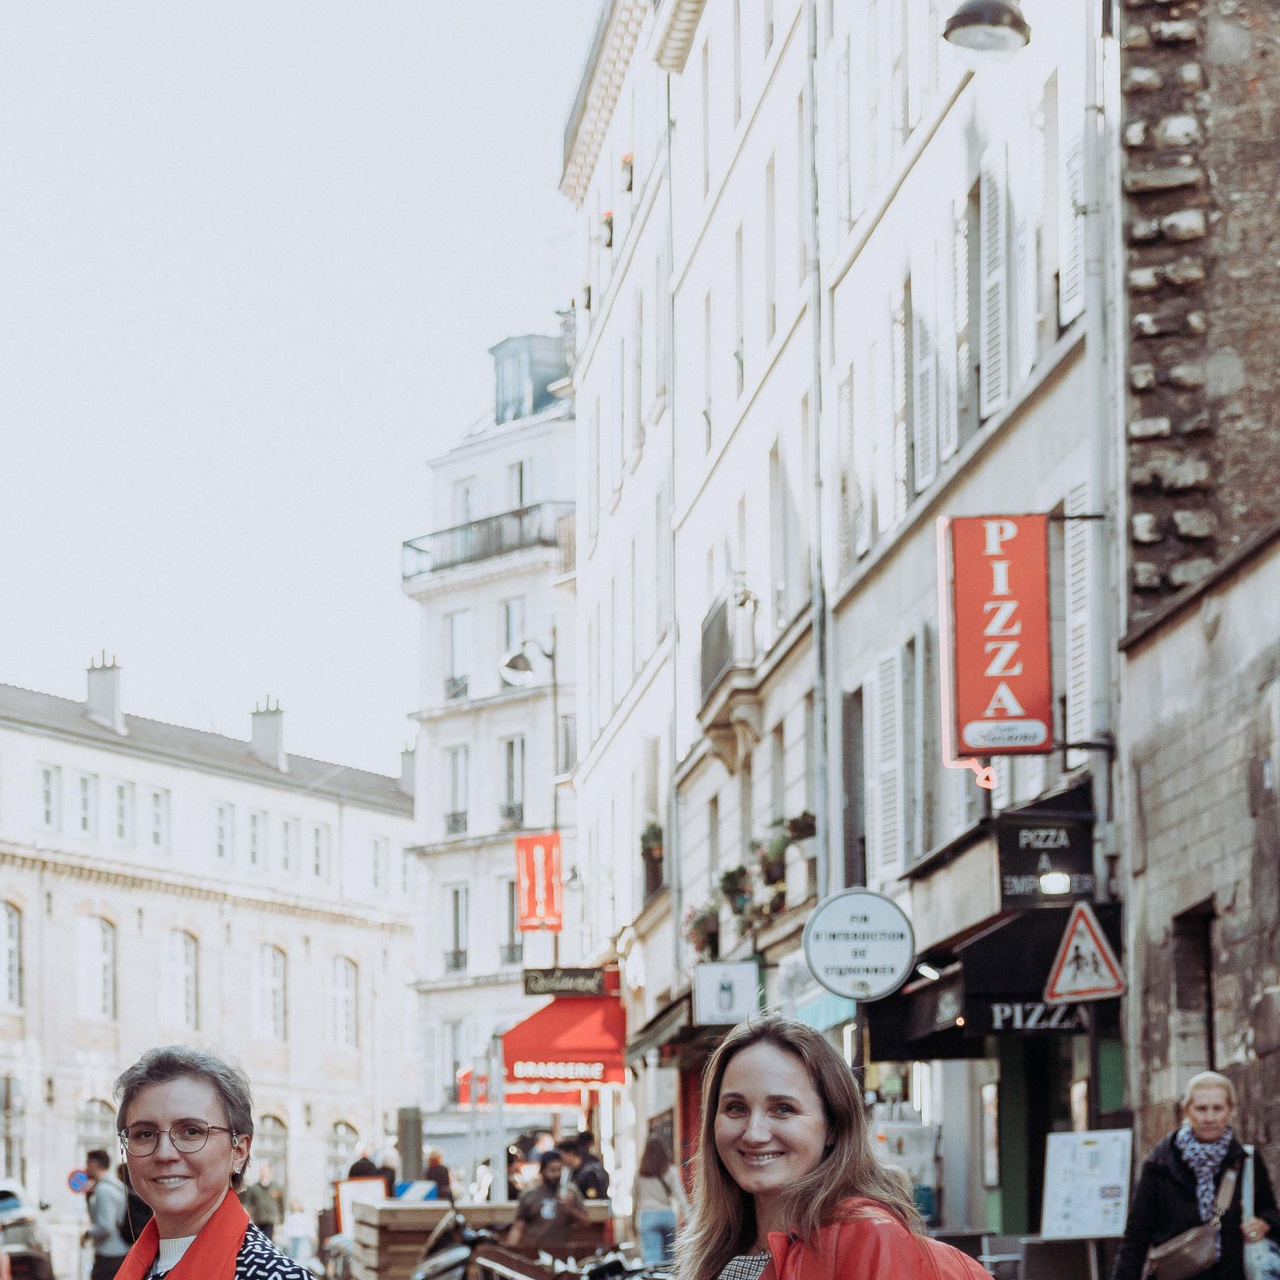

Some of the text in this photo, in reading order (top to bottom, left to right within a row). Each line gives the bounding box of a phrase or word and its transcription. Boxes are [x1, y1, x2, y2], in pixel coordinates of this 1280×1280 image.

[982, 519, 1025, 717] PIZZA
[1019, 828, 1071, 849] PIZZA
[1003, 873, 1095, 896] EMPER
[991, 1002, 1090, 1030] PIZZA
